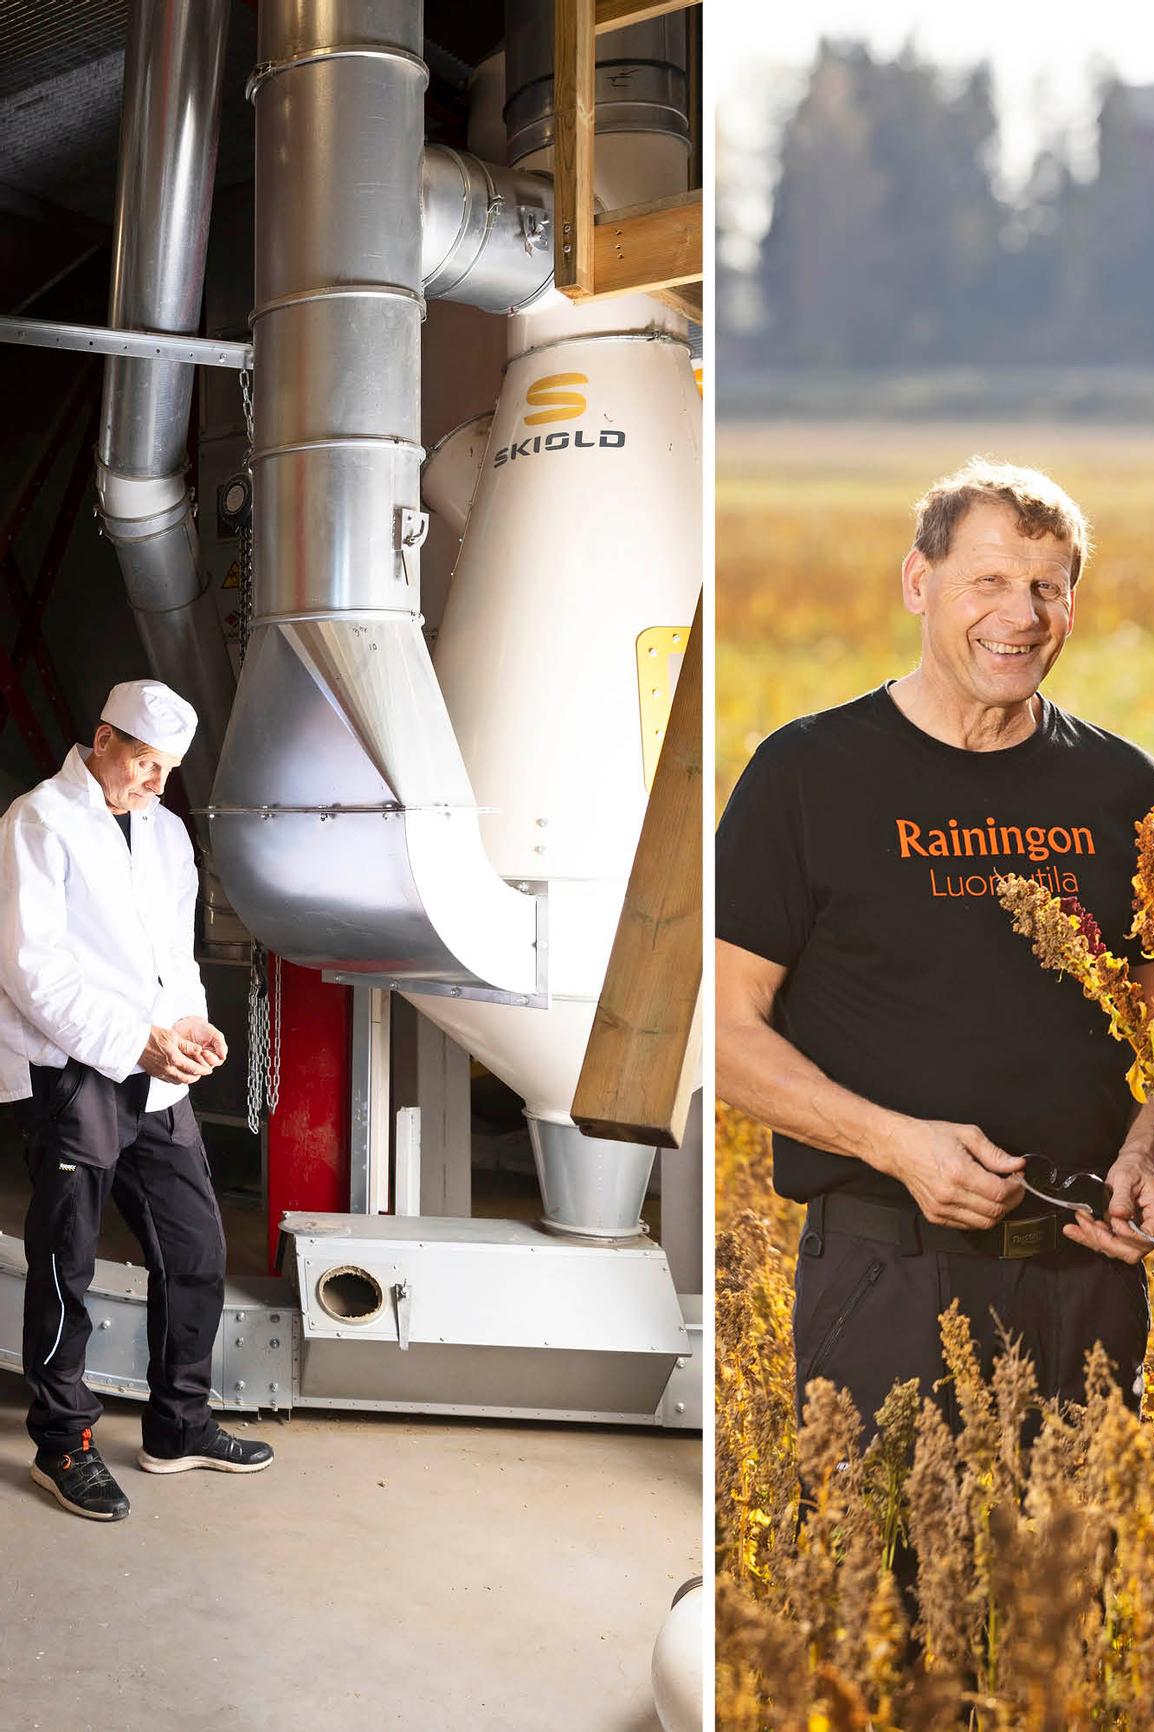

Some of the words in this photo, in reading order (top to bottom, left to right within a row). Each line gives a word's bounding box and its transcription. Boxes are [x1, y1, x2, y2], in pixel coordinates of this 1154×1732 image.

[494, 430, 626, 468] SKIOLD
[895, 816, 1096, 862] Rainingon
[930, 865, 1079, 897] Luotila
